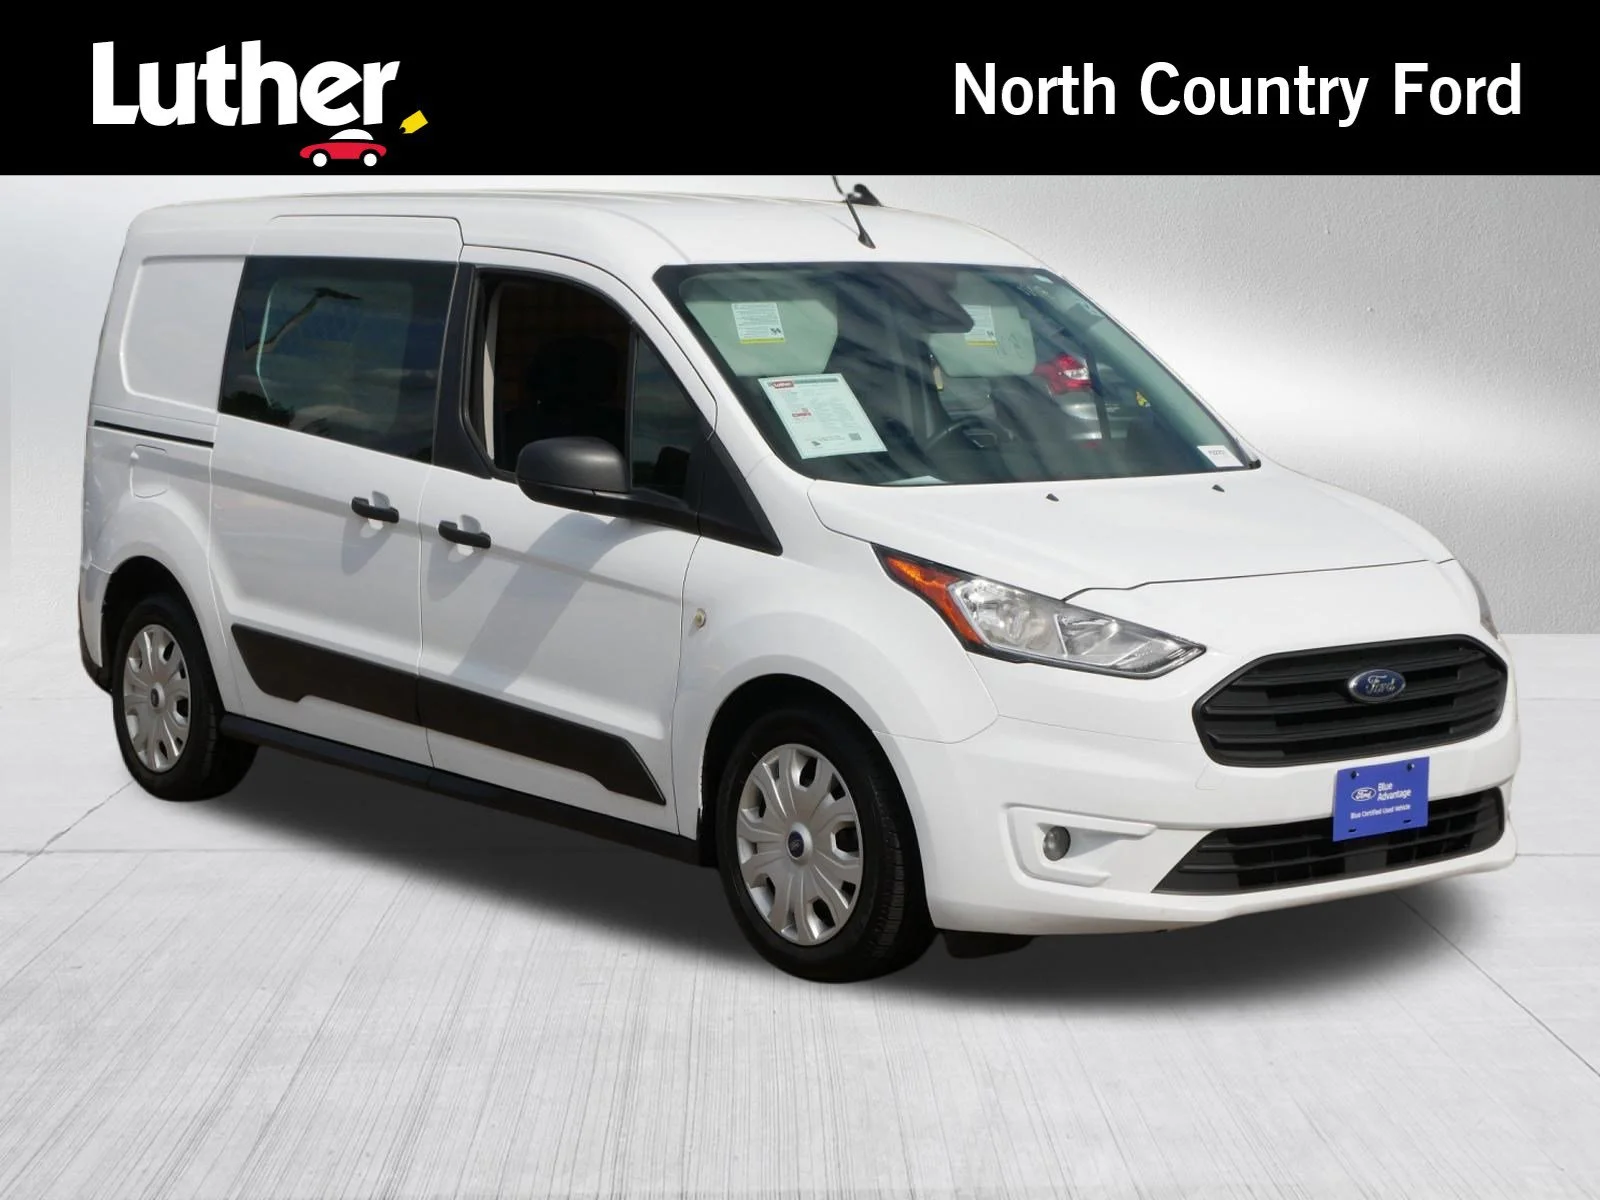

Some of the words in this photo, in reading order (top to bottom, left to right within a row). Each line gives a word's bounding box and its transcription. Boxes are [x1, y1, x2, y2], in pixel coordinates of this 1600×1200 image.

[1366, 675, 1396, 694] Ford
[1377, 782, 1393, 791] Blue
[1377, 789, 1412, 801] Advantage
[1361, 808, 1382, 817] Certified
